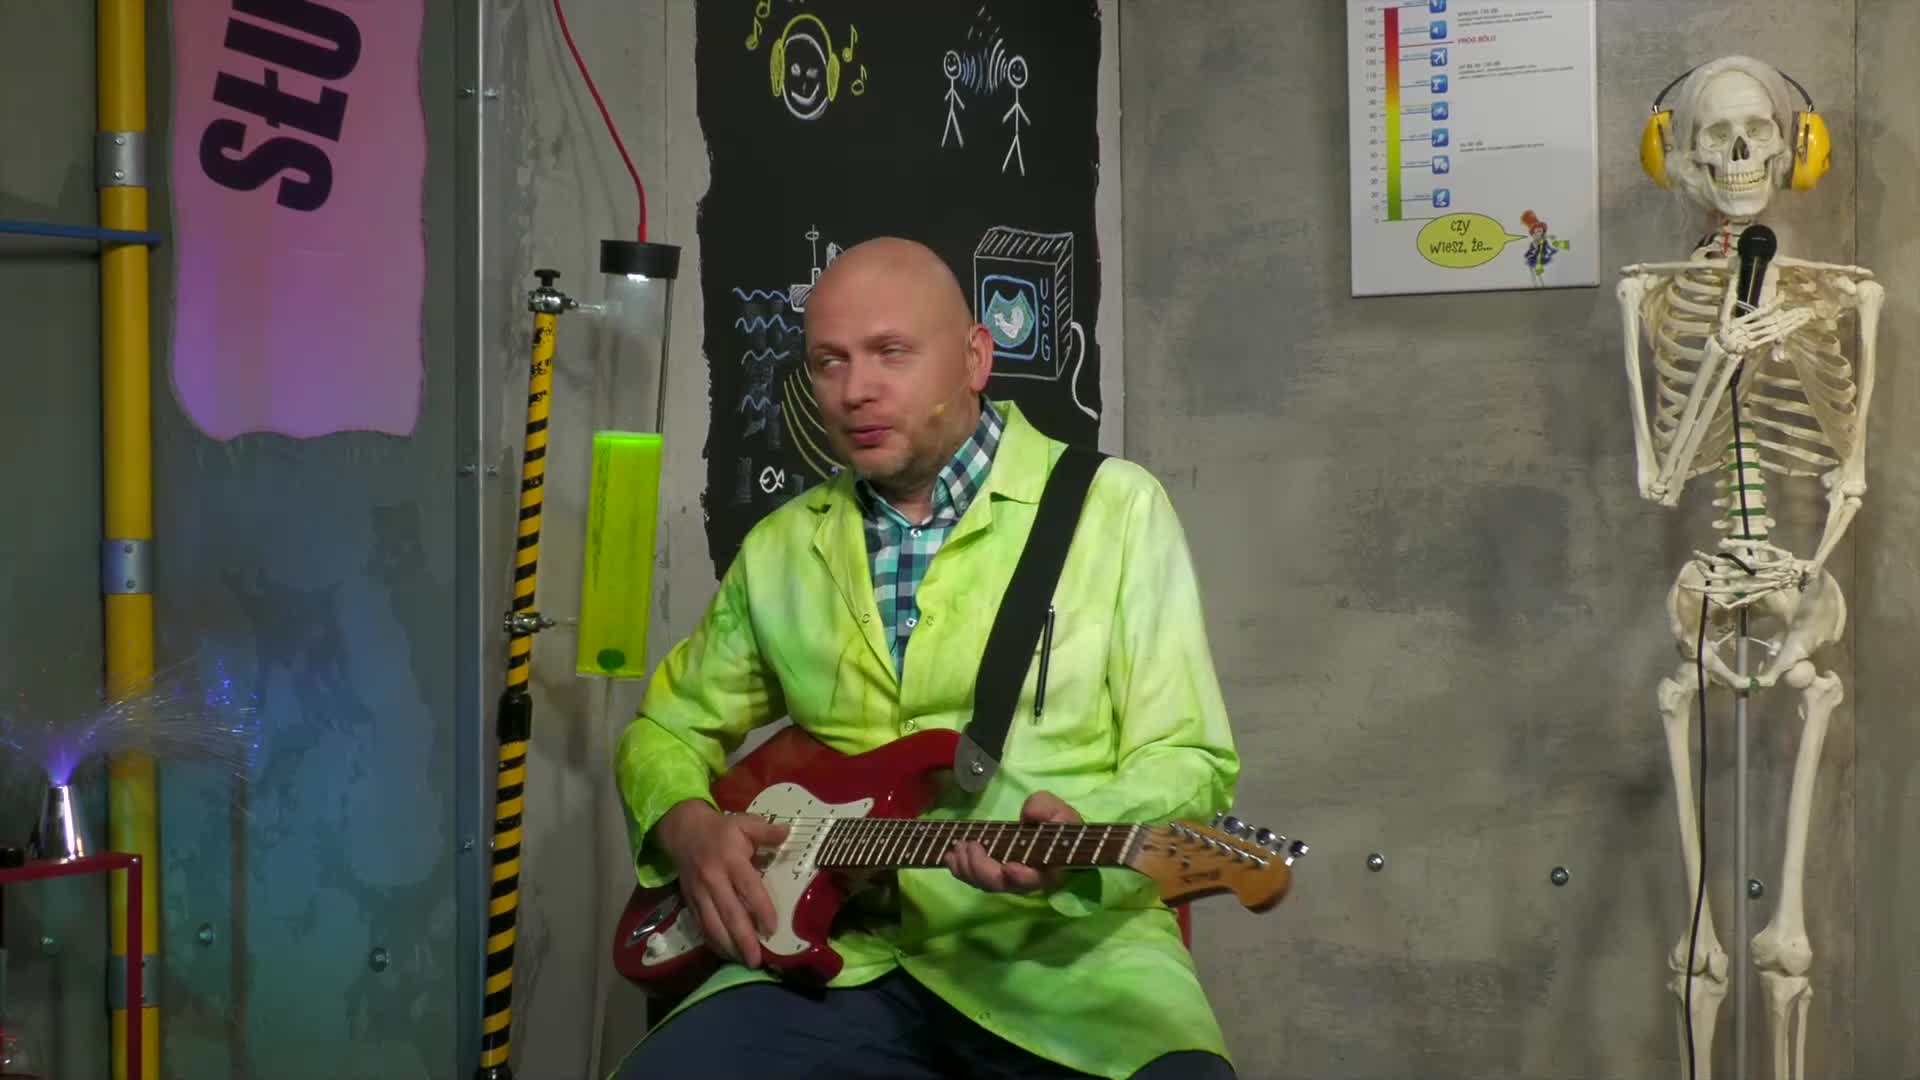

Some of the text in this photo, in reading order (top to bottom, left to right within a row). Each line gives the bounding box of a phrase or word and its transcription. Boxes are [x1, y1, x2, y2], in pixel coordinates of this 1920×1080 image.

[1450, 219, 1471, 236] czy
[1471, 237, 1494, 252] że...
[1039, 277, 1051, 362] USG
